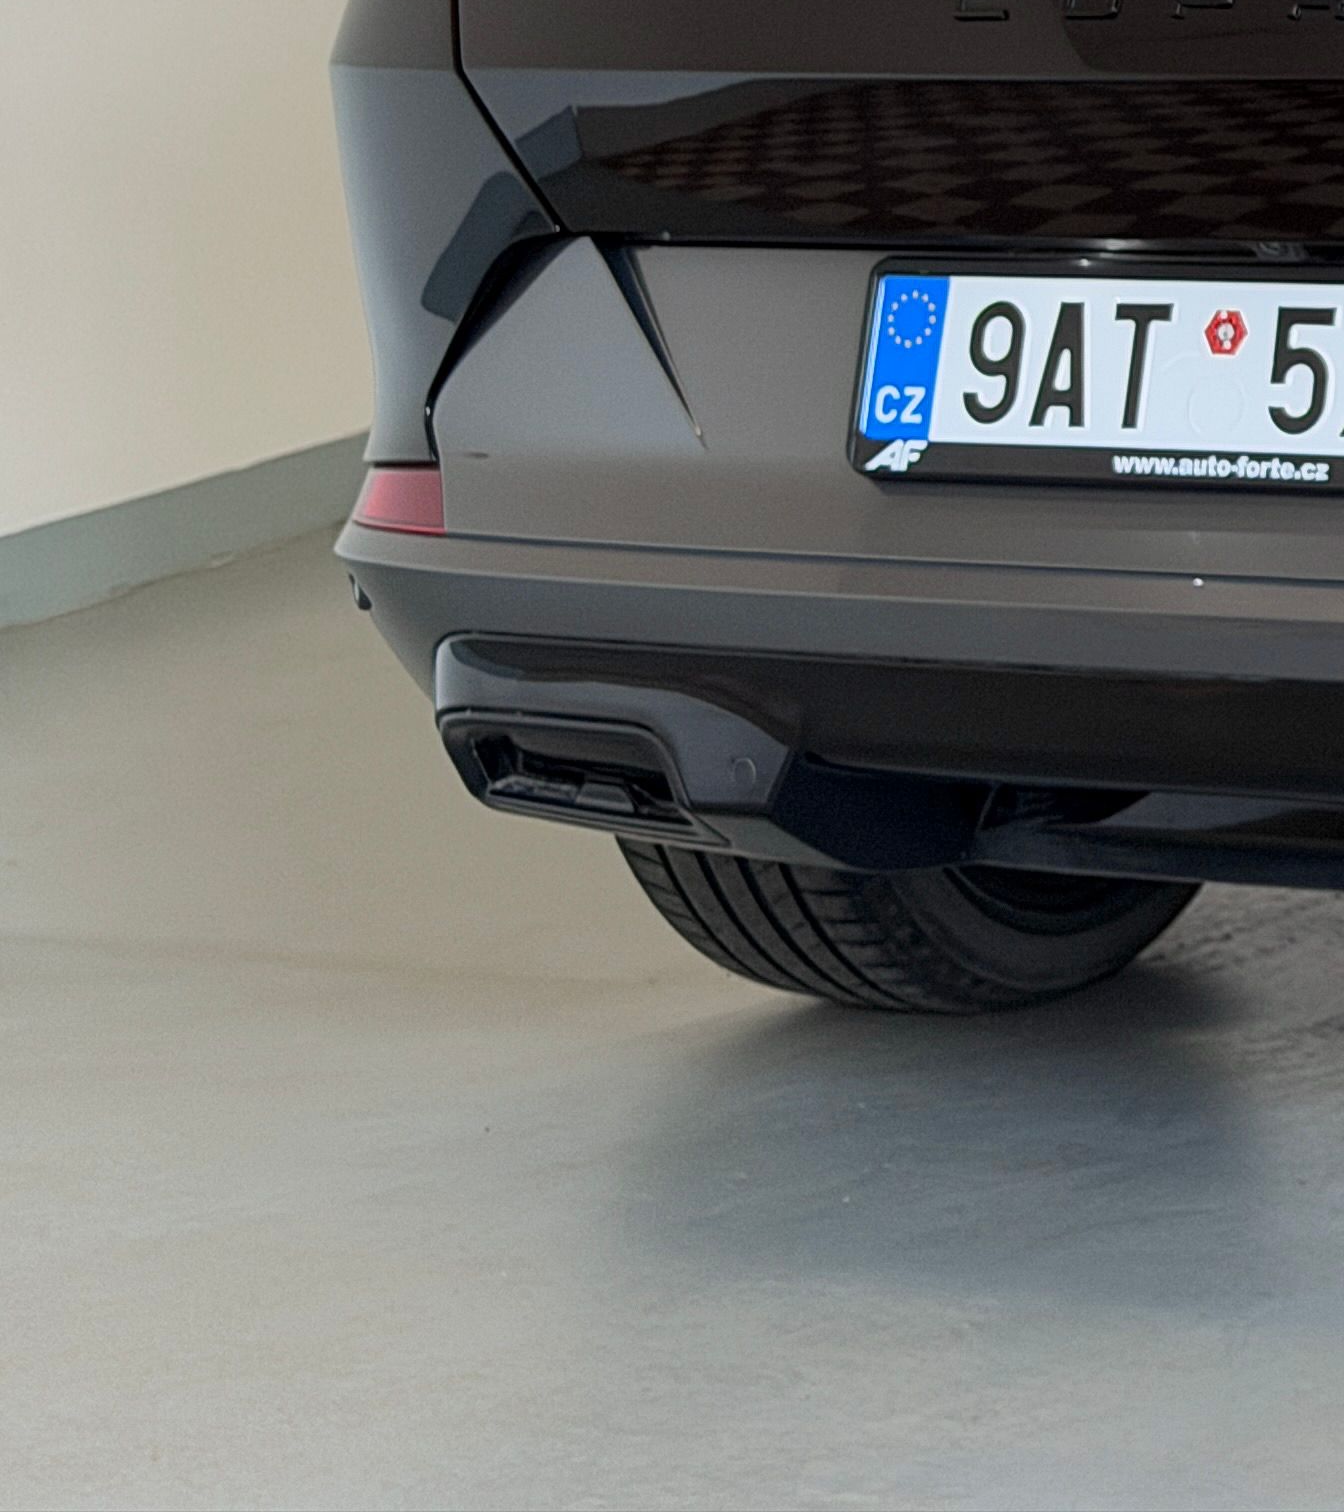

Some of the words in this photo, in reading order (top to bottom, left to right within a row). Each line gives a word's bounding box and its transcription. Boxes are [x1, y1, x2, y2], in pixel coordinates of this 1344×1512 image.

[962, 300, 1174, 429] 9AT
[875, 384, 926, 424] CZ
[864, 438, 928, 472] AF
[1113, 455, 1330, 482] www.auto-forte.cz
